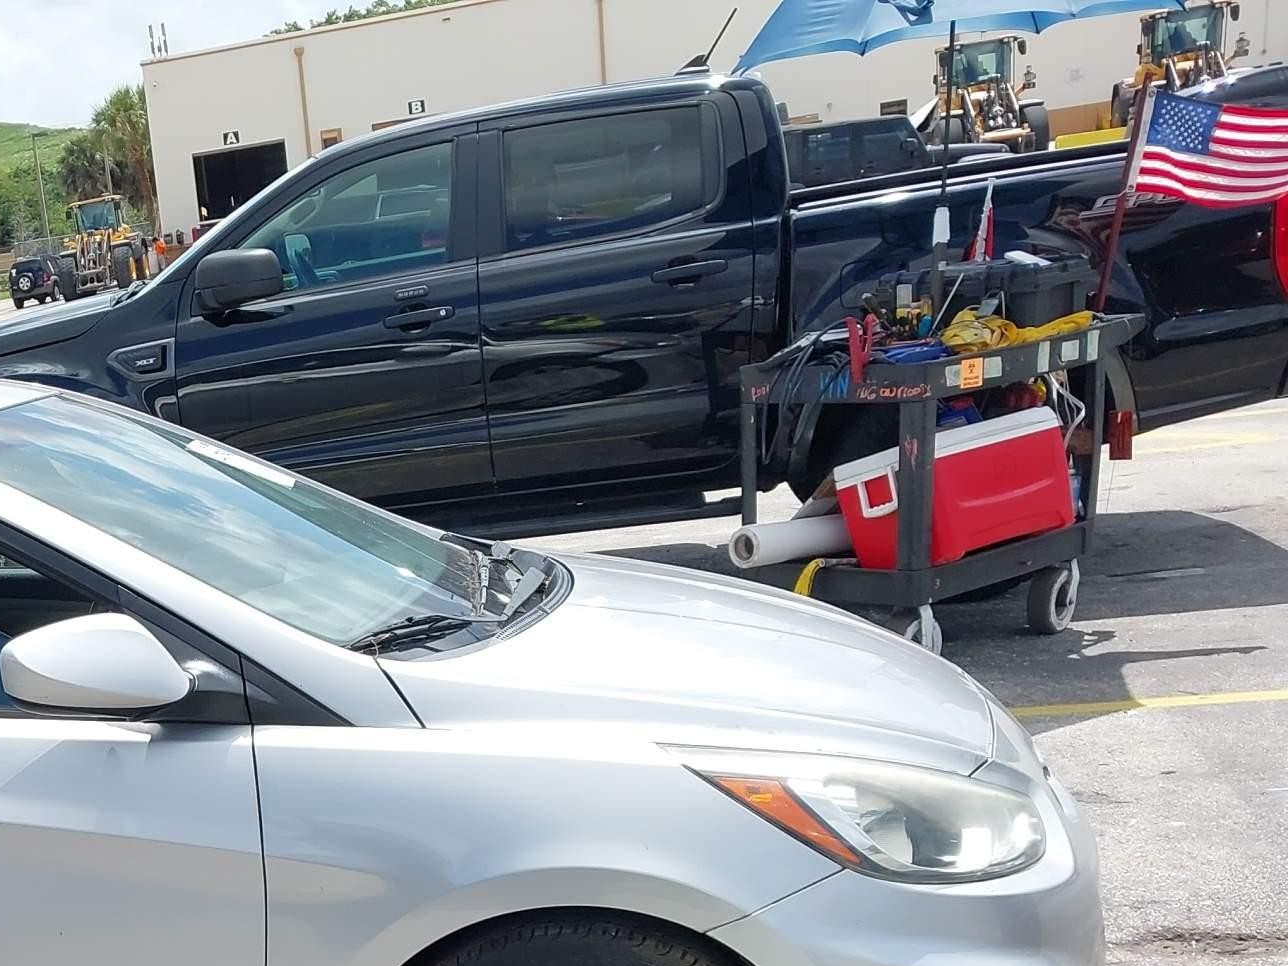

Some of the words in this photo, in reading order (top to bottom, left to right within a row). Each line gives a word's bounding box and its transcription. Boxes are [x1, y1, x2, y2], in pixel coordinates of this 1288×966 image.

[411, 101, 423, 113] B
[225, 131, 238, 145] A
[135, 357, 157, 367] XLT
